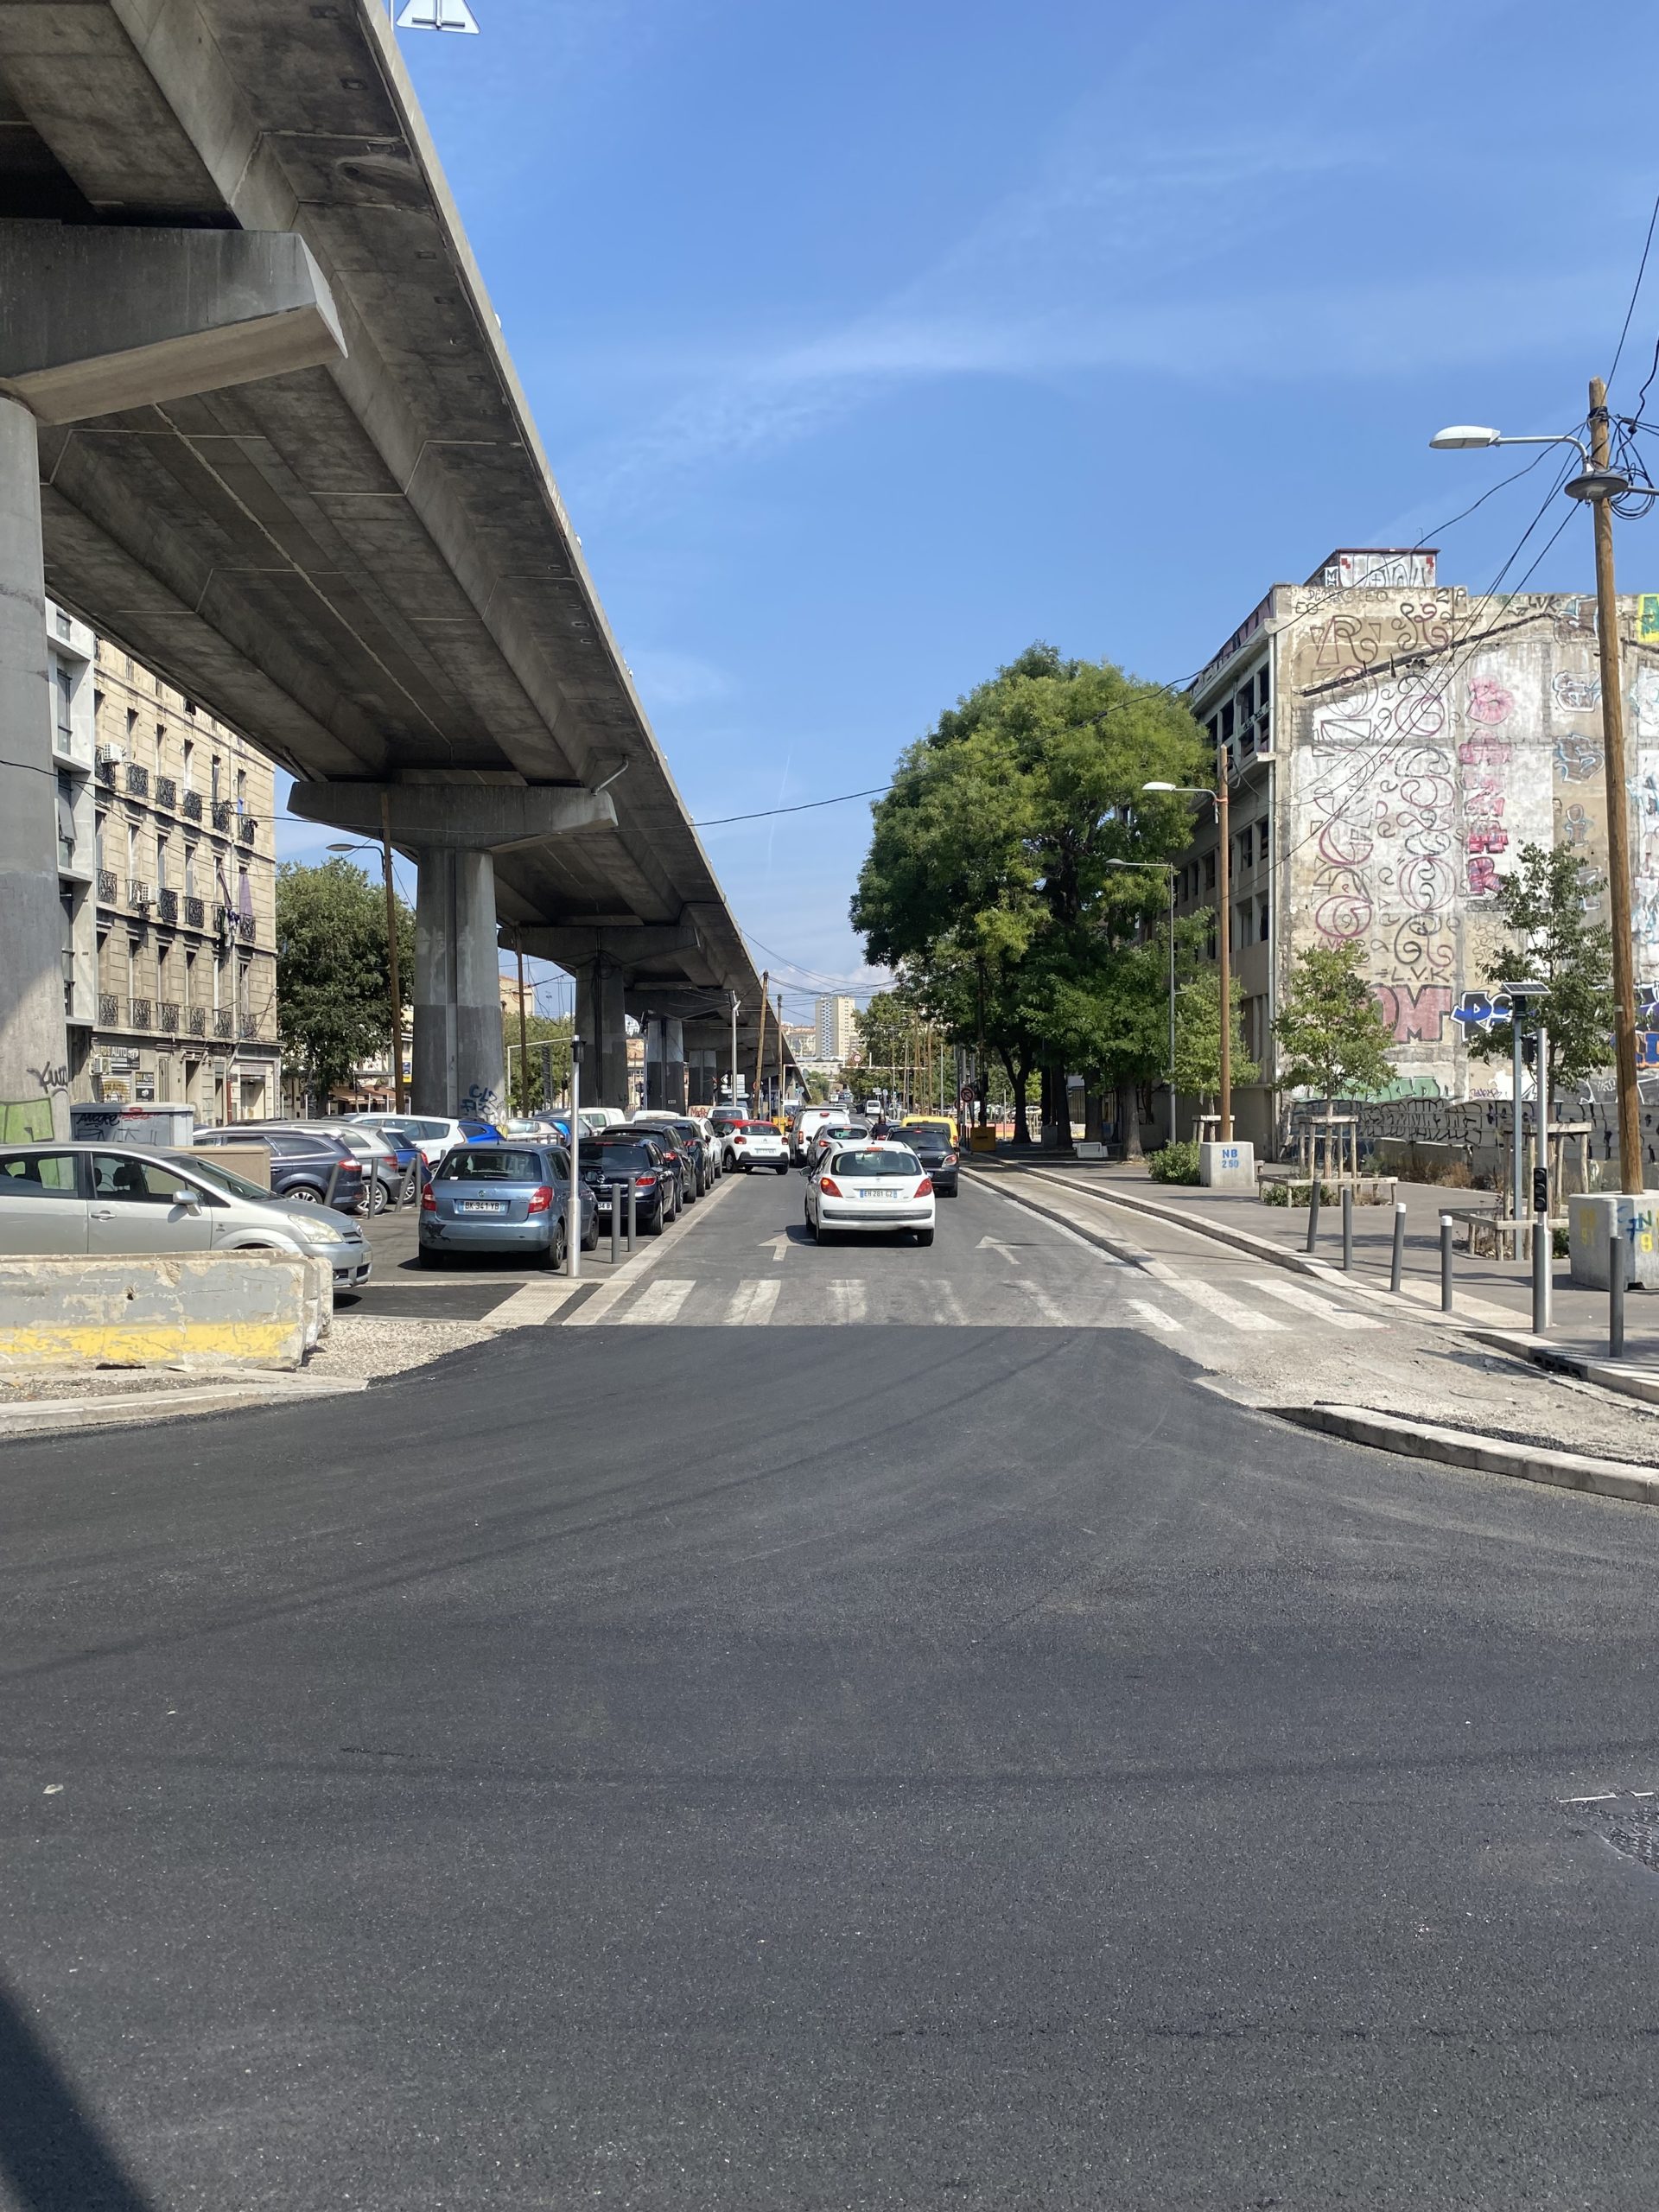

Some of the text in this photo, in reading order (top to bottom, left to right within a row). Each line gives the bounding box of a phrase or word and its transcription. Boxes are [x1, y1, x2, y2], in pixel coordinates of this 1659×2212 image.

[111, 1046, 128, 1058] AUTO
[1222, 1148, 1237, 1159] NB
[1222, 1160, 1239, 1169] 250
